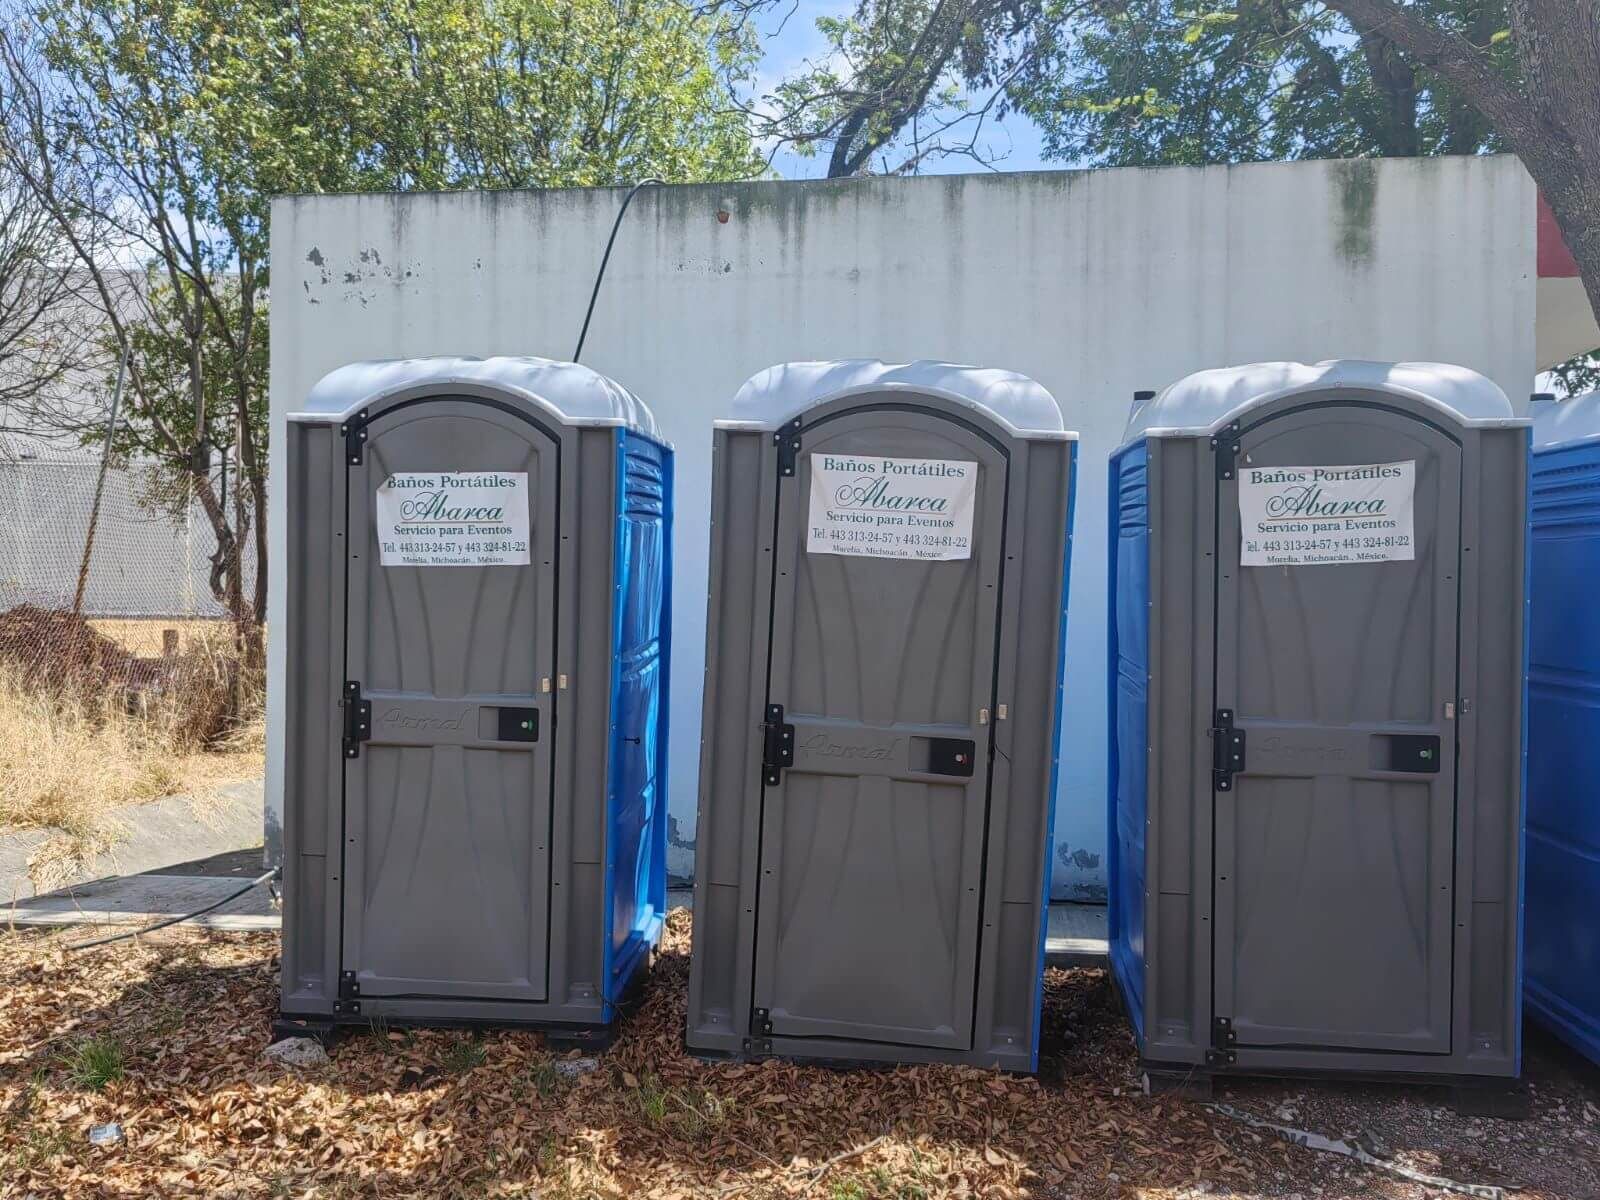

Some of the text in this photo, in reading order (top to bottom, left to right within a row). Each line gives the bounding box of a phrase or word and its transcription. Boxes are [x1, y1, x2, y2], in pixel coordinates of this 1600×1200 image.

[824, 458, 965, 477] Baños Portátiles
[1251, 466, 1401, 484] Baños Portátiles
[387, 475, 516, 488] Baños Portátiles
[835, 475, 948, 511] Abarca
[1266, 483, 1387, 517] Abarca
[400, 490, 504, 520] Abarca
[826, 511, 954, 528] Servicio para Eventos
[1258, 520, 1396, 534] Servicio para Eventos
[394, 525, 512, 537] Servicio para Eventos
[813, 528, 967, 547] Tel. 443 313-24-57 y 443 324-81-22
[383, 542, 526, 554] Tel. 443 313-24-57 y 443 324-81-22
[1263, 541, 1280, 551] 443
[1283, 538, 1331, 550] 313-24-57
[1334, 541, 1339, 551] y
[1342, 538, 1360, 548] 443
[1363, 536, 1409, 547] 324-81-22
